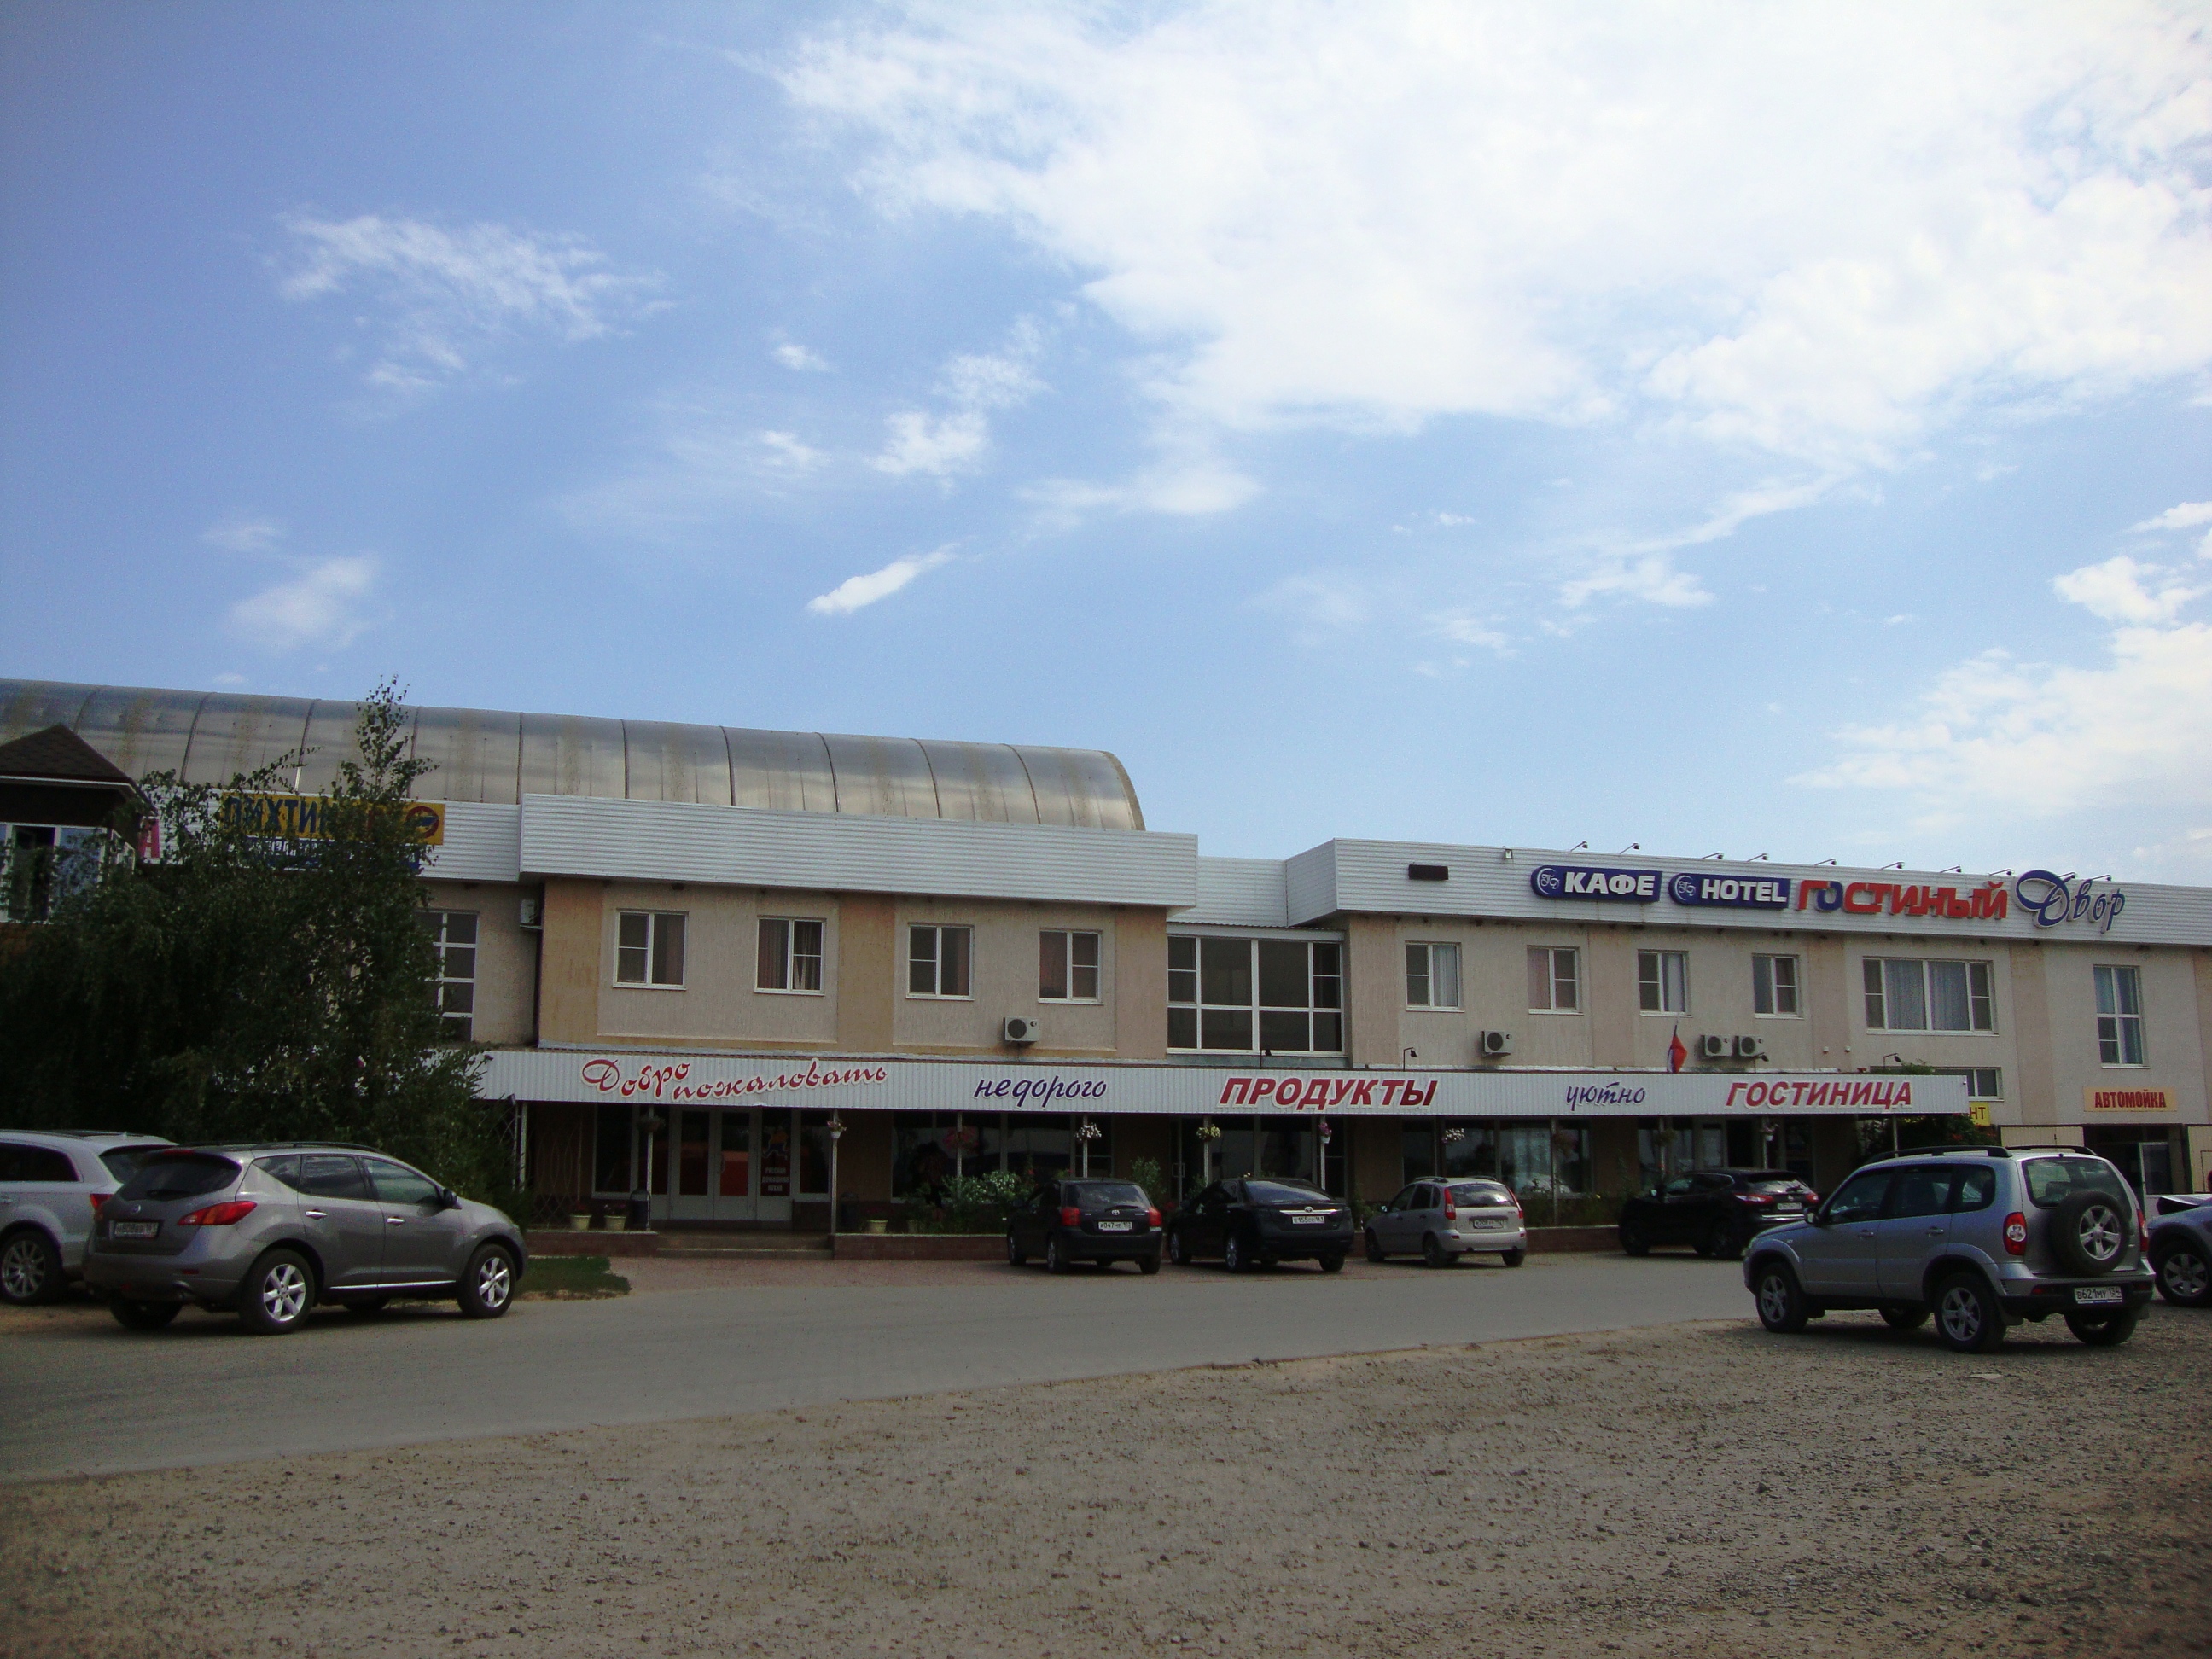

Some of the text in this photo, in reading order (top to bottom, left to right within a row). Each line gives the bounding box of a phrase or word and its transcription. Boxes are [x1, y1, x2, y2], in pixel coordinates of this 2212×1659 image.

[1564, 871, 1656, 896] КАФЕ
[1701, 878, 1788, 903] HOTEL
[1797, 869, 2126, 932] ГОСТИНЫЙ Двор
[582, 1058, 690, 1098] Добро
[672, 1060, 889, 1100] пожаловать
[974, 1075, 1107, 1108] недорого
[1219, 1077, 1439, 1111] ПРОДУКТЫ
[1566, 1081, 1646, 1112] уютно
[1725, 1080, 1912, 1110] ГОСТИНИЦА
[2094, 1089, 2167, 1109] АВТОМОЙКА
